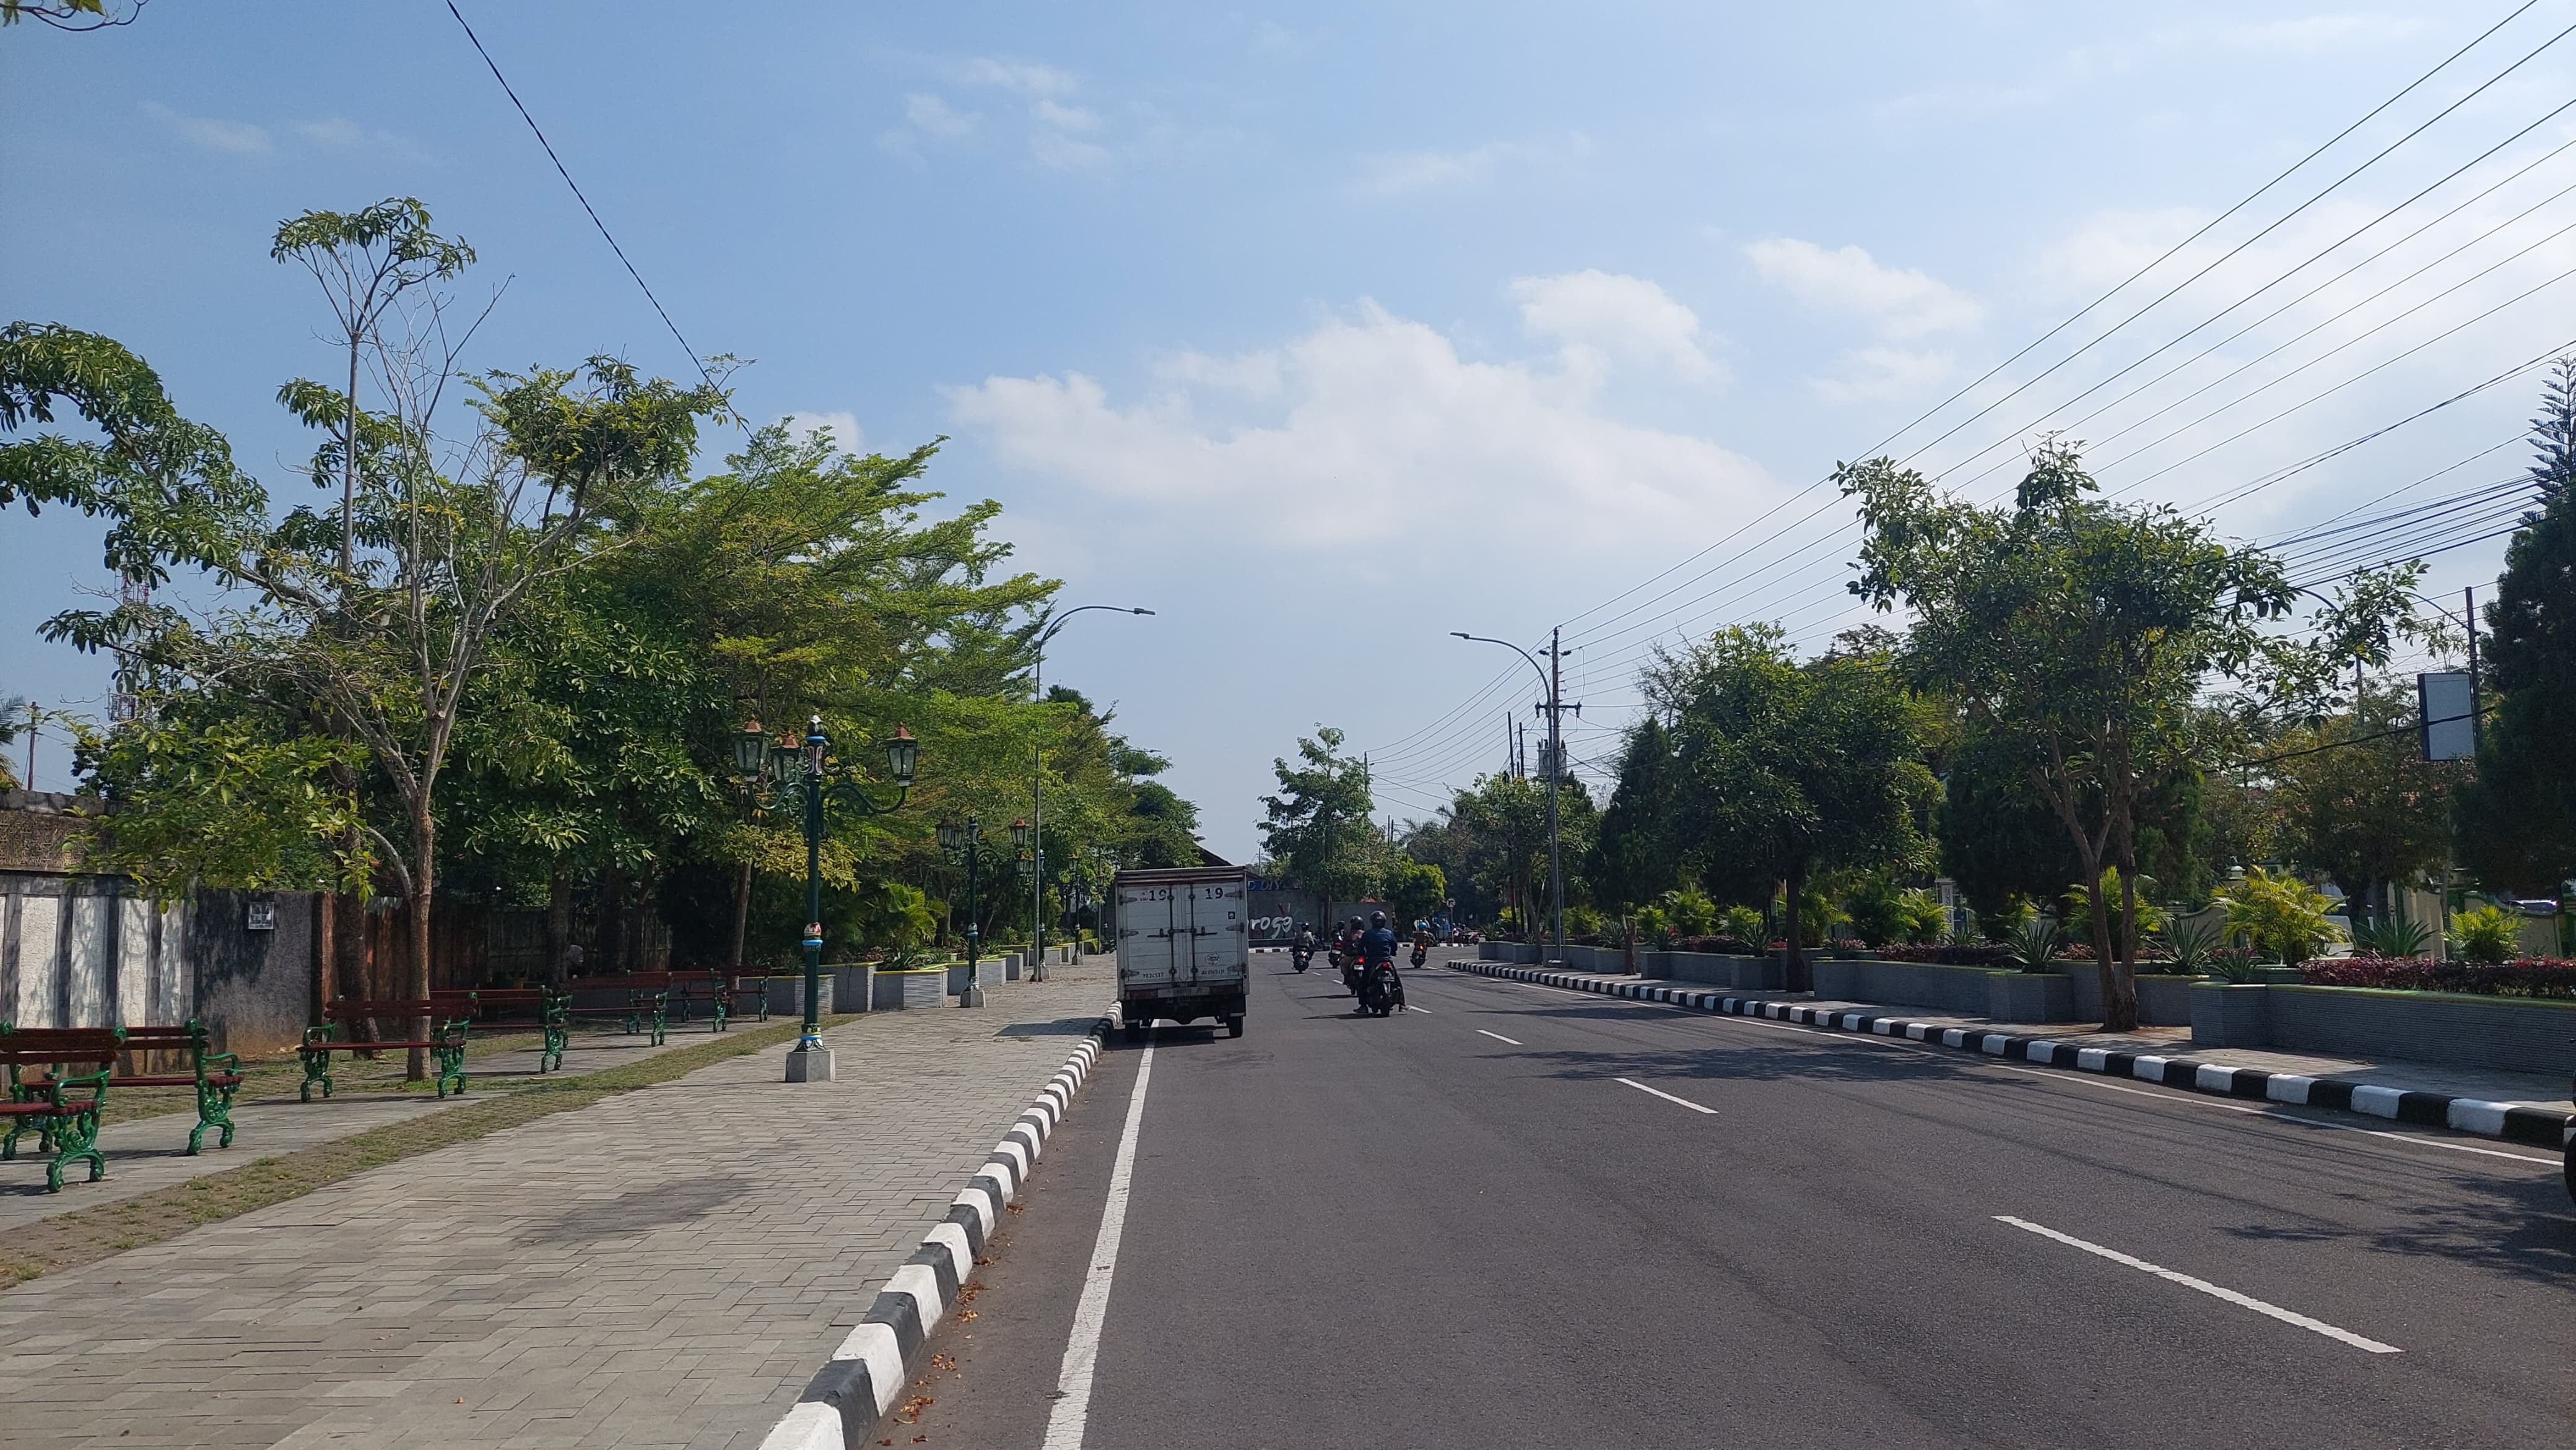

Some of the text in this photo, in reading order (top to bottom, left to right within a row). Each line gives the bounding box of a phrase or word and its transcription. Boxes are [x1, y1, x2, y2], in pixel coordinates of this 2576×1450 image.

[1149, 889, 1167, 901] 19
[1205, 887, 1224, 900] 19
[1247, 916, 1294, 939] rogo
